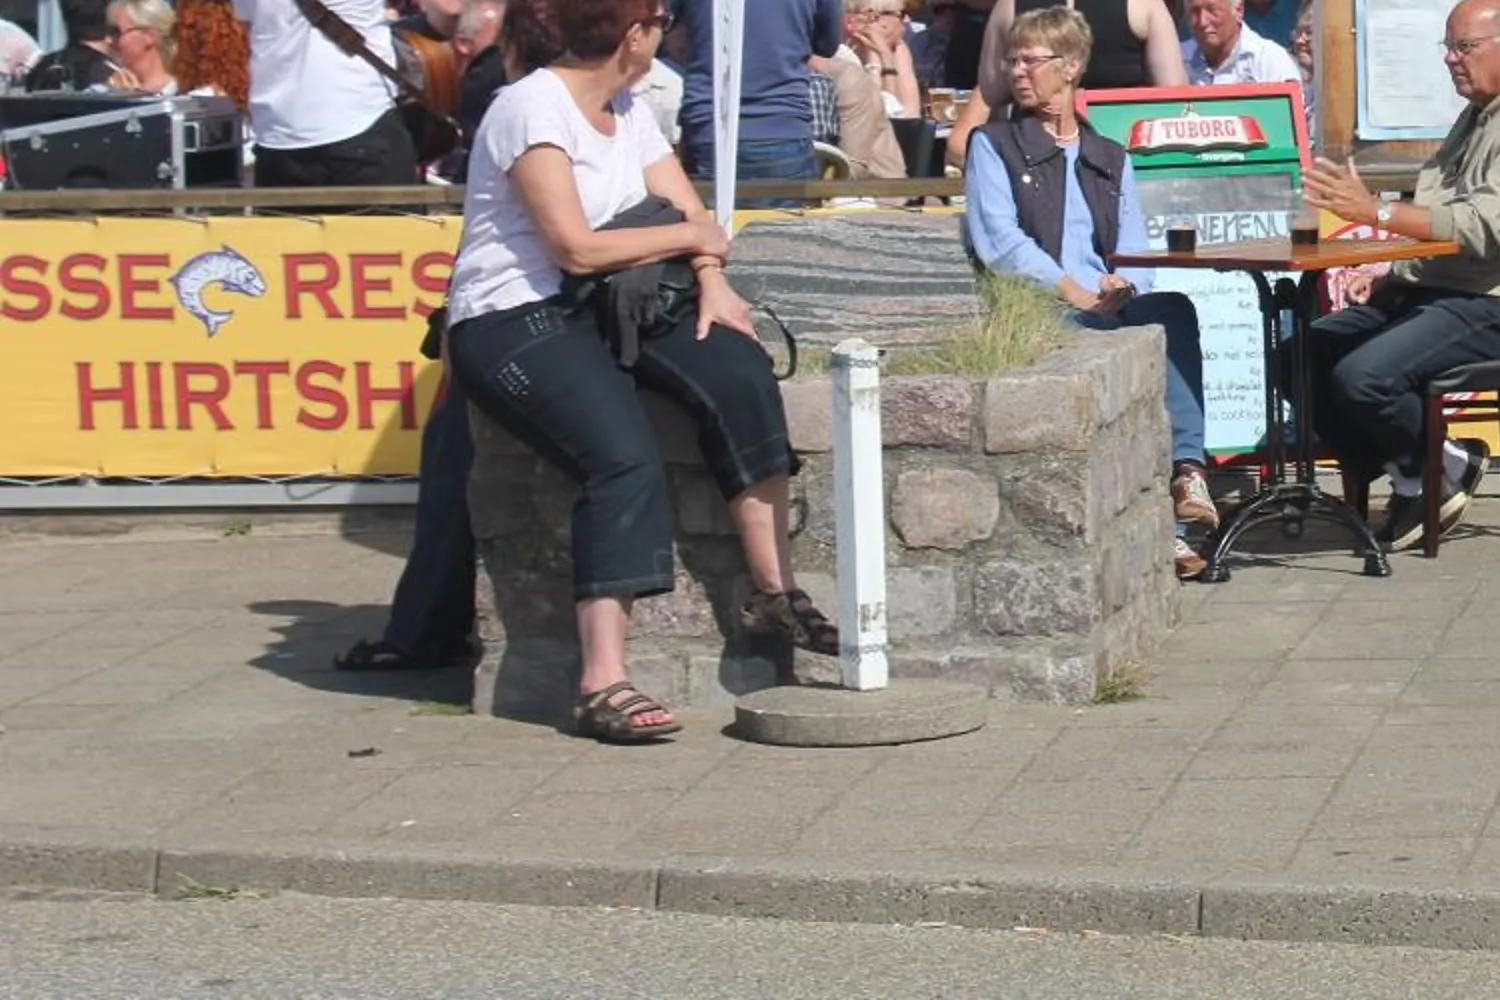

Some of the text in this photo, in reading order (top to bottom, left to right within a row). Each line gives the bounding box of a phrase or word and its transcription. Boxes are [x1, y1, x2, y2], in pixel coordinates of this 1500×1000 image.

[1160, 119, 1237, 139] TUBORG
[1145, 211, 1291, 243] BNEMENU
[0, 252, 175, 322] SSE
[74, 360, 447, 431] HIRTSH
